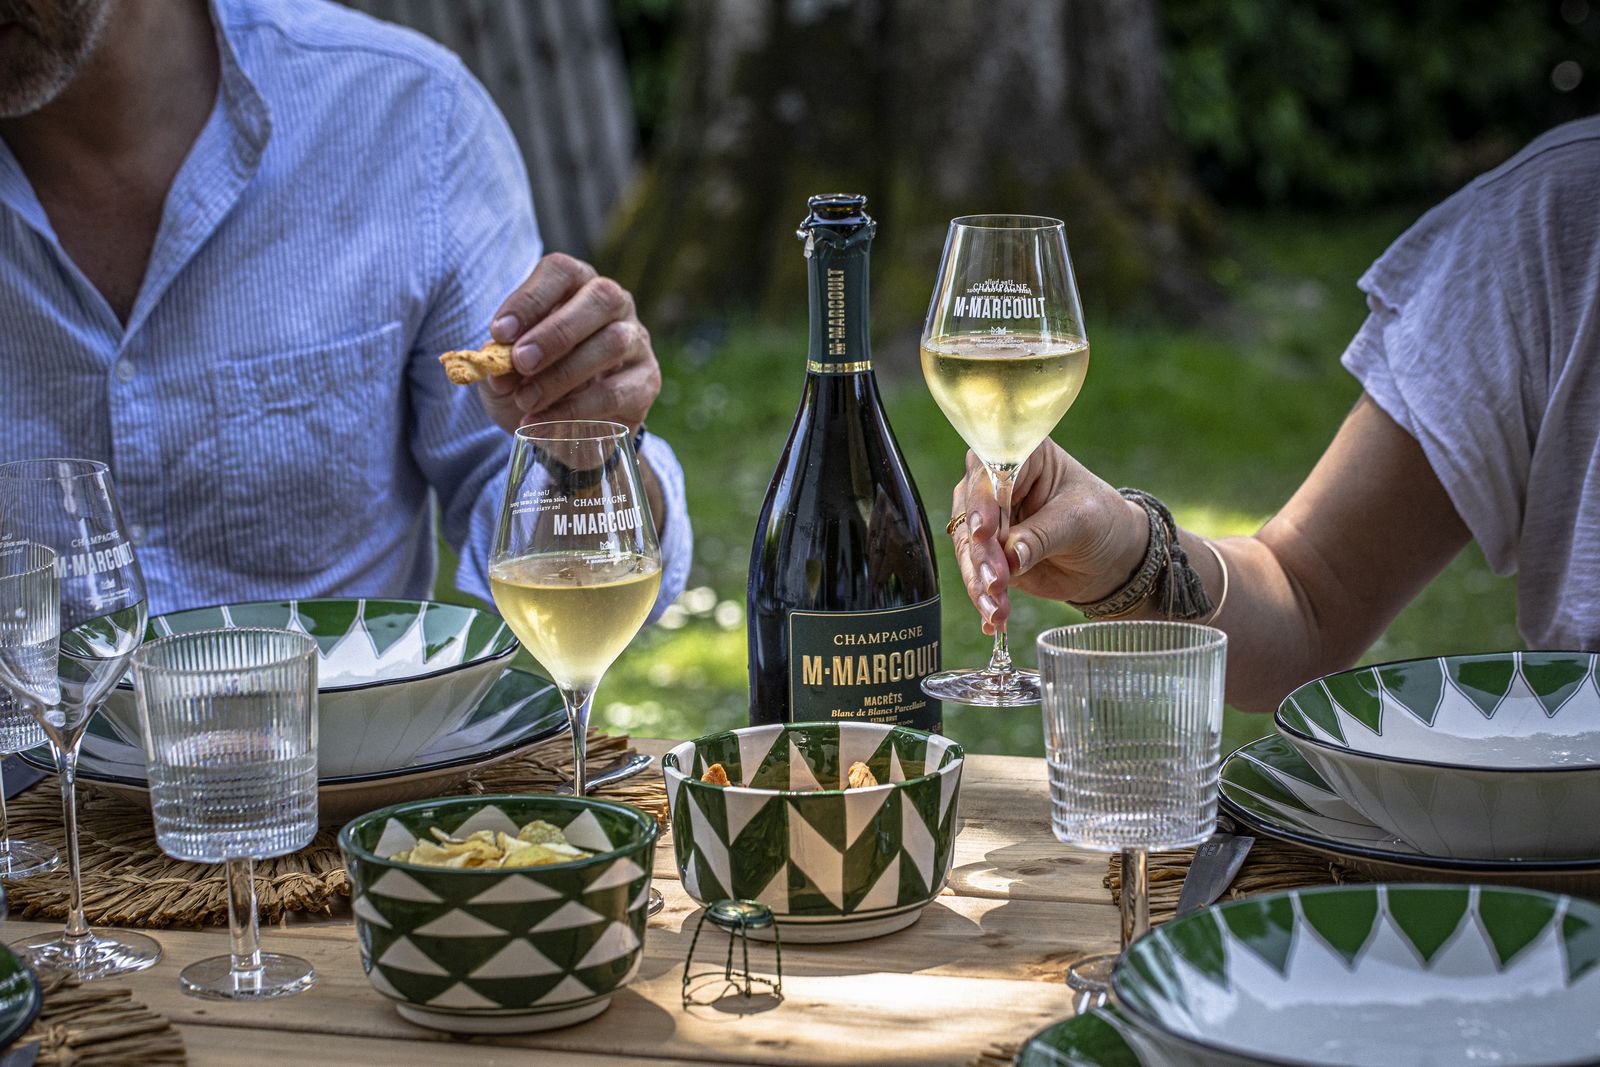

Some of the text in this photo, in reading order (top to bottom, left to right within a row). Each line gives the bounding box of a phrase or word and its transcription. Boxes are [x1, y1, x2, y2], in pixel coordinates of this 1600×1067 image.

[573, 494, 627, 507] CHAMPAGNE
[834, 625, 923, 646] CHAMPAGNE
[864, 692, 903, 706] MACRÊTS
[832, 709, 854, 717] Blanc
[868, 707, 892, 716] Blancs
